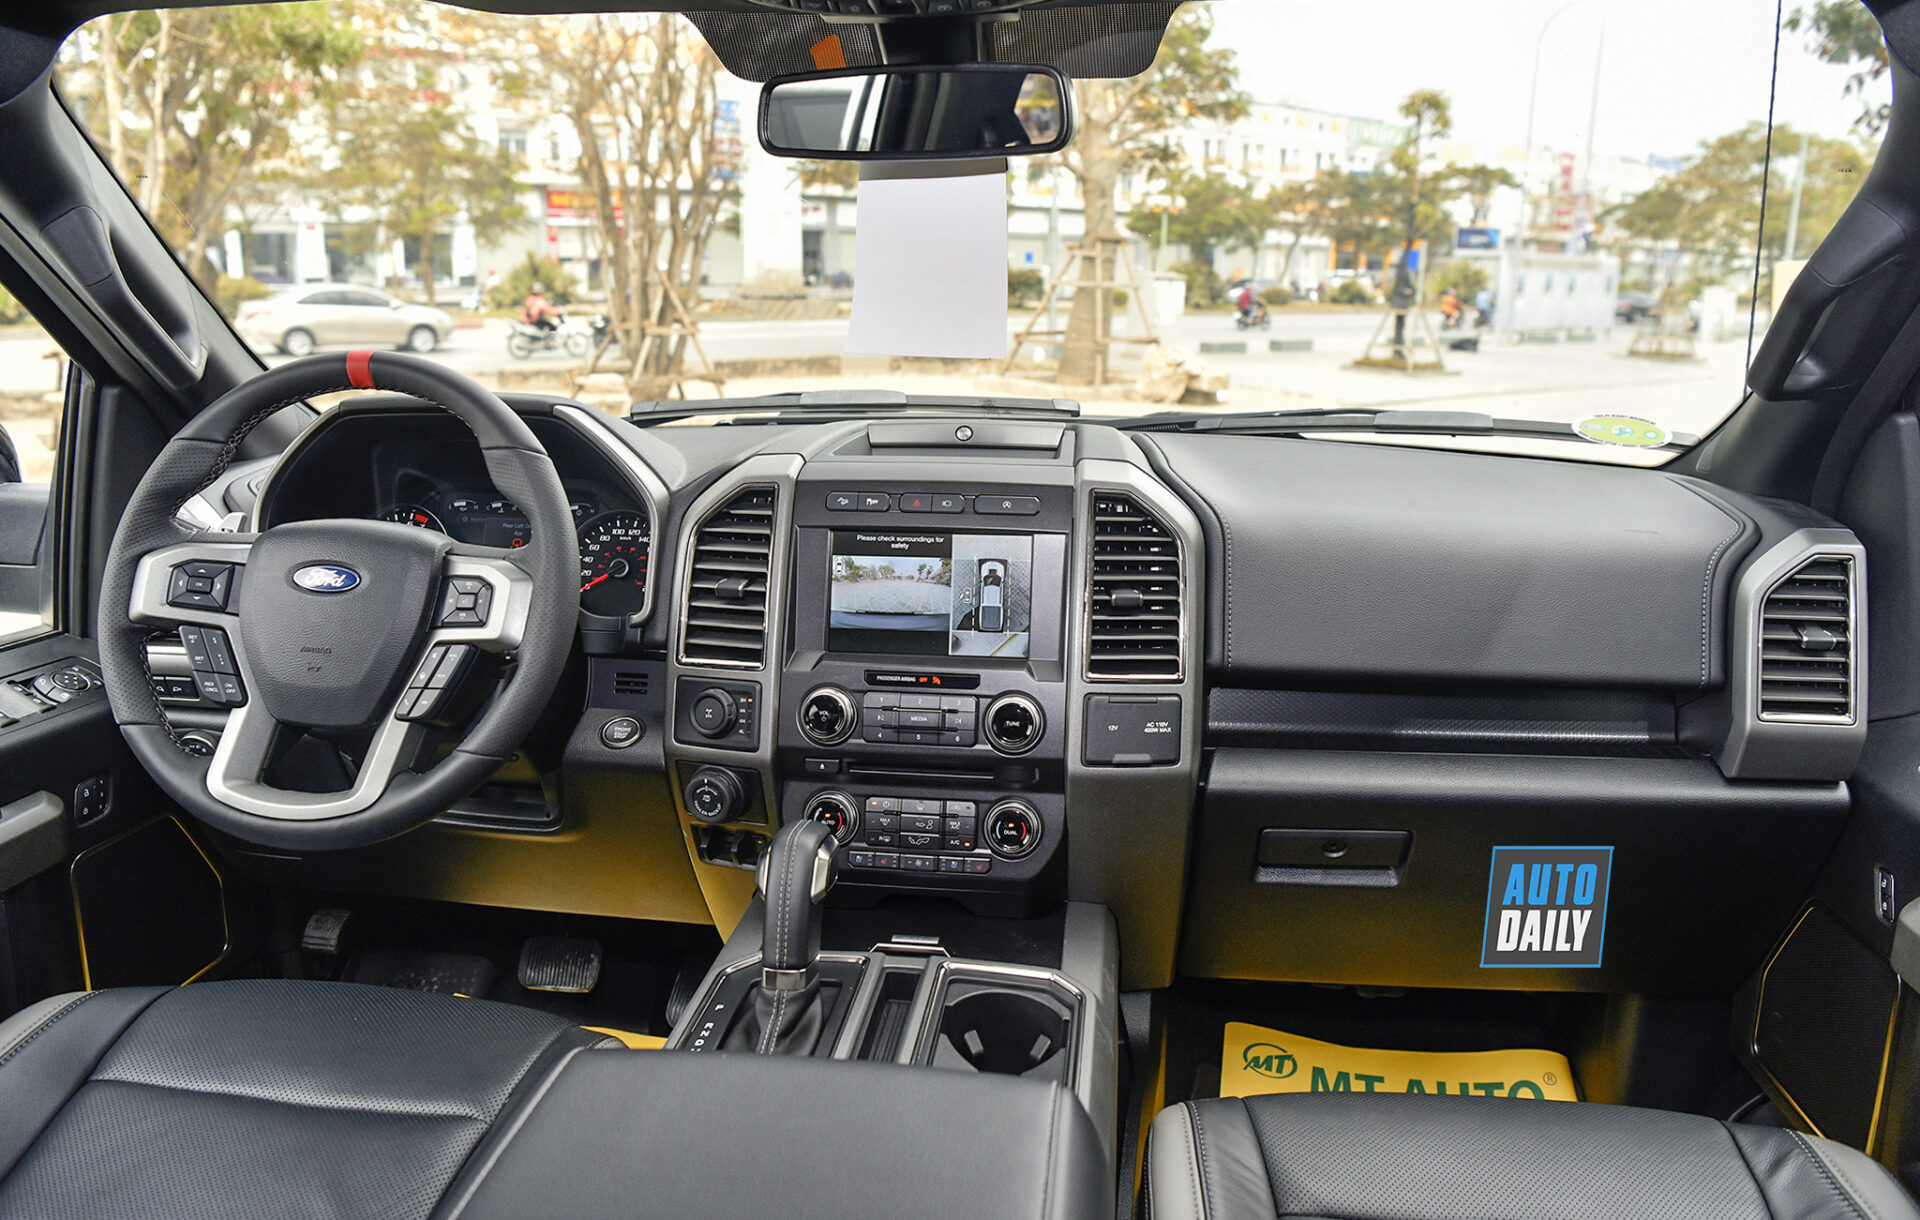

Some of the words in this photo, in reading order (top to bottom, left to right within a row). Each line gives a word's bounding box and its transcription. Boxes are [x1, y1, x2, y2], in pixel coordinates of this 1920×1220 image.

[612, 528, 625, 536] 100
[628, 528, 641, 536] 120
[600, 534, 611, 542] 80
[896, 536, 934, 544] surroundings
[891, 542, 910, 550] safety
[581, 569, 592, 577] 20
[304, 568, 346, 588] Ford
